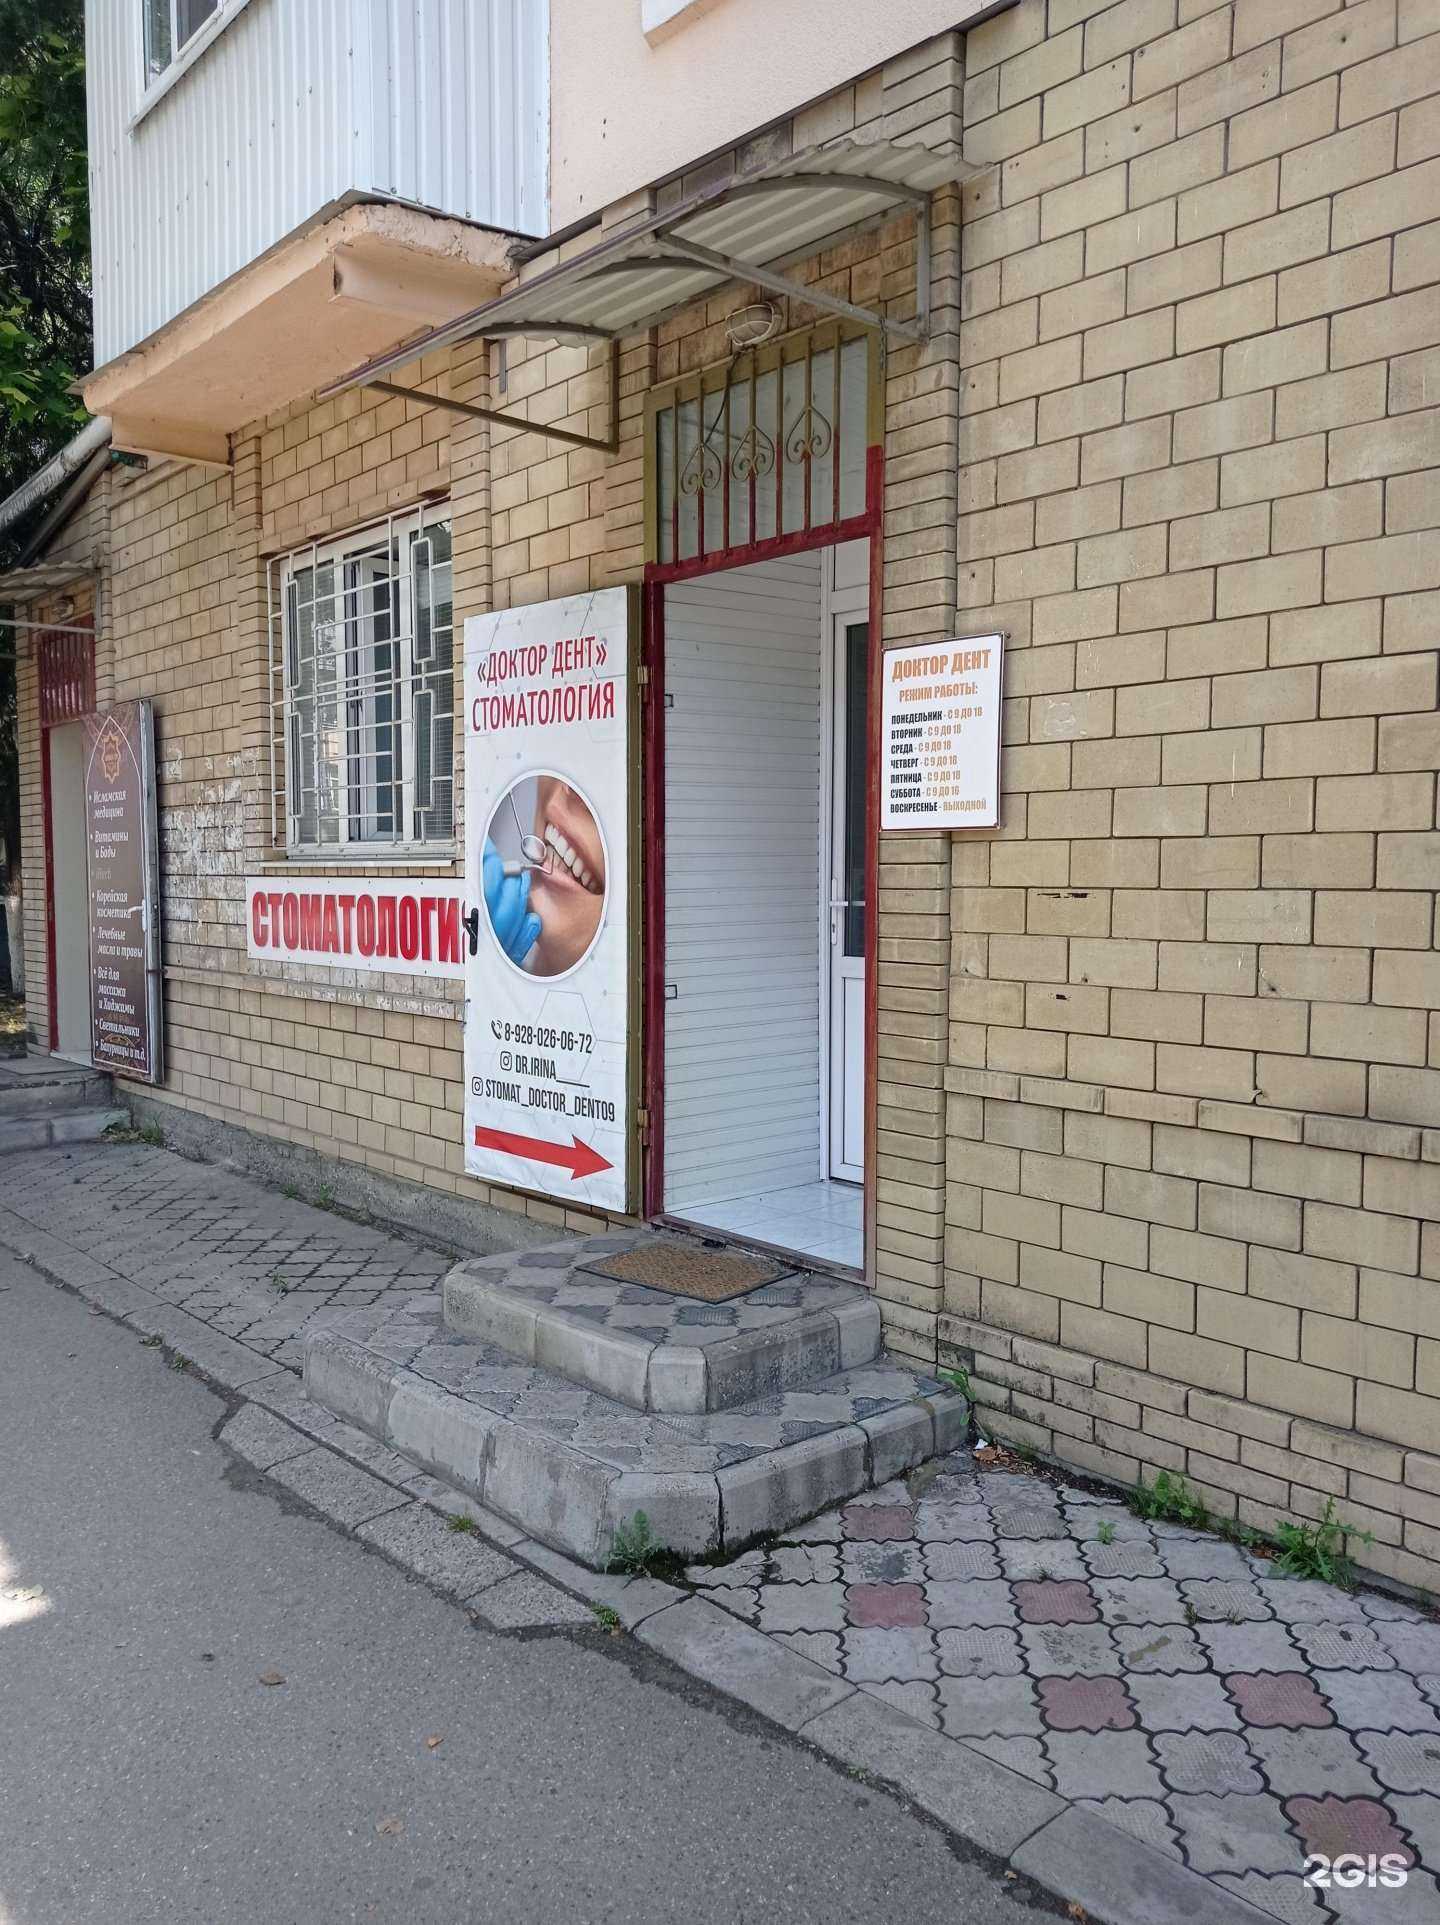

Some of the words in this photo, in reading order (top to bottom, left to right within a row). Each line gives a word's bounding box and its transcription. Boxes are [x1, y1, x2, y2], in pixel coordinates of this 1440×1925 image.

[478, 644, 548, 688] «ДОКТОР
[552, 636, 607, 679] ДЕНТ»
[892, 654, 948, 683] ДОКТОР
[951, 649, 992, 676] ДЕНТ
[899, 686, 933, 703] РЕЖИМ
[934, 682, 978, 700] РАБОТЫ:
[472, 681, 615, 732] СТОМАТОЛОГИЯ
[891, 710, 943, 725] ПОНЕДЕЛЬНИК
[961, 707, 972, 720] ДО
[891, 728, 923, 740] ВТОРНИК
[940, 725, 952, 737] ДО
[891, 743, 913, 755] СРЕДА
[931, 740, 942, 753] ДО
[890, 758, 919, 769] ЧЕТВЕРГ
[937, 756, 948, 768] ДО
[890, 773, 922, 785] ПЯТНИЦА
[940, 770, 950, 782] ДО
[94, 790, 127, 803] Исламская
[890, 787, 921, 799] СУББОТА
[939, 786, 949, 798] ДО
[890, 801, 938, 814] ВОСКРЕСЕНЬЕ
[943, 798, 986, 812] ВЫХОДНОЙ
[96, 831, 128, 842] Витамины
[97, 889, 128, 906] Корейская
[98, 927, 126, 941] Лечебные
[252, 891, 465, 964] СТОМАТОЛОГИ
[504, 1022, 592, 1054] 8-928-026-06-72
[486, 1078, 615, 1122] STOMAT_DOCTOR_DENT09
